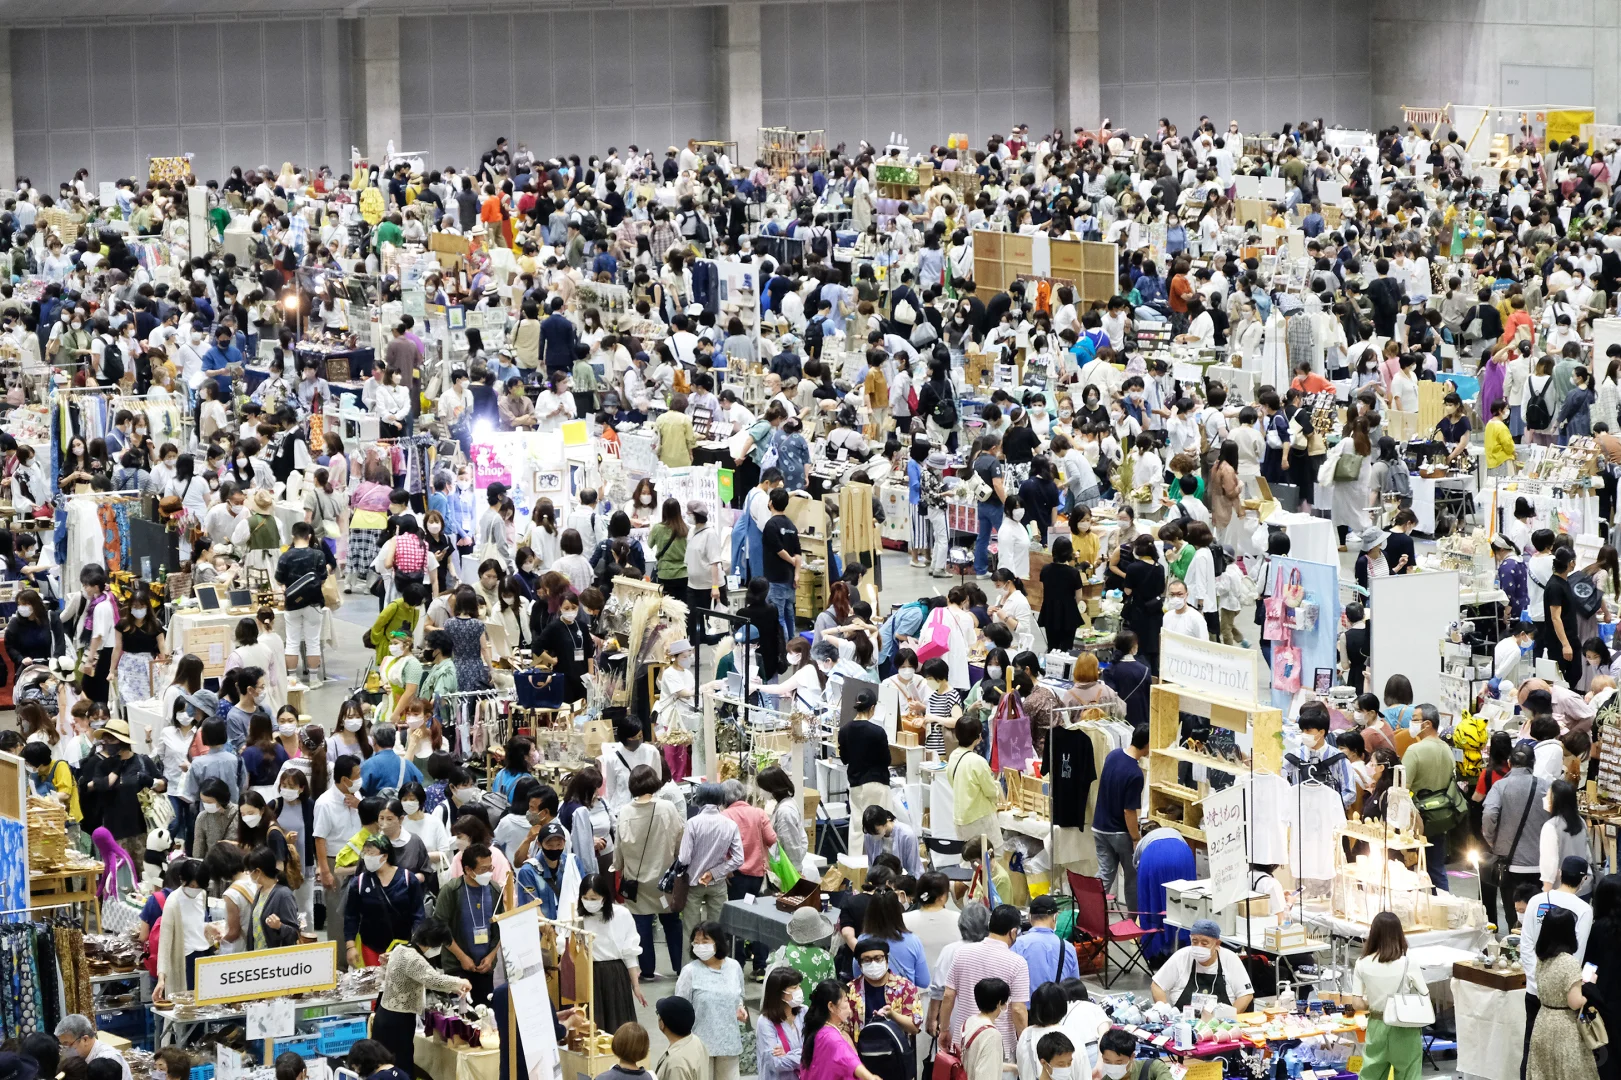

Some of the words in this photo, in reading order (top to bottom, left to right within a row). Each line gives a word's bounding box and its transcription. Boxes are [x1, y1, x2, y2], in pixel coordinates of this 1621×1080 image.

[477, 465, 504, 477] Shop
[1206, 804, 1241, 828] 焼きもの
[219, 962, 312, 985] SESESEstudio
